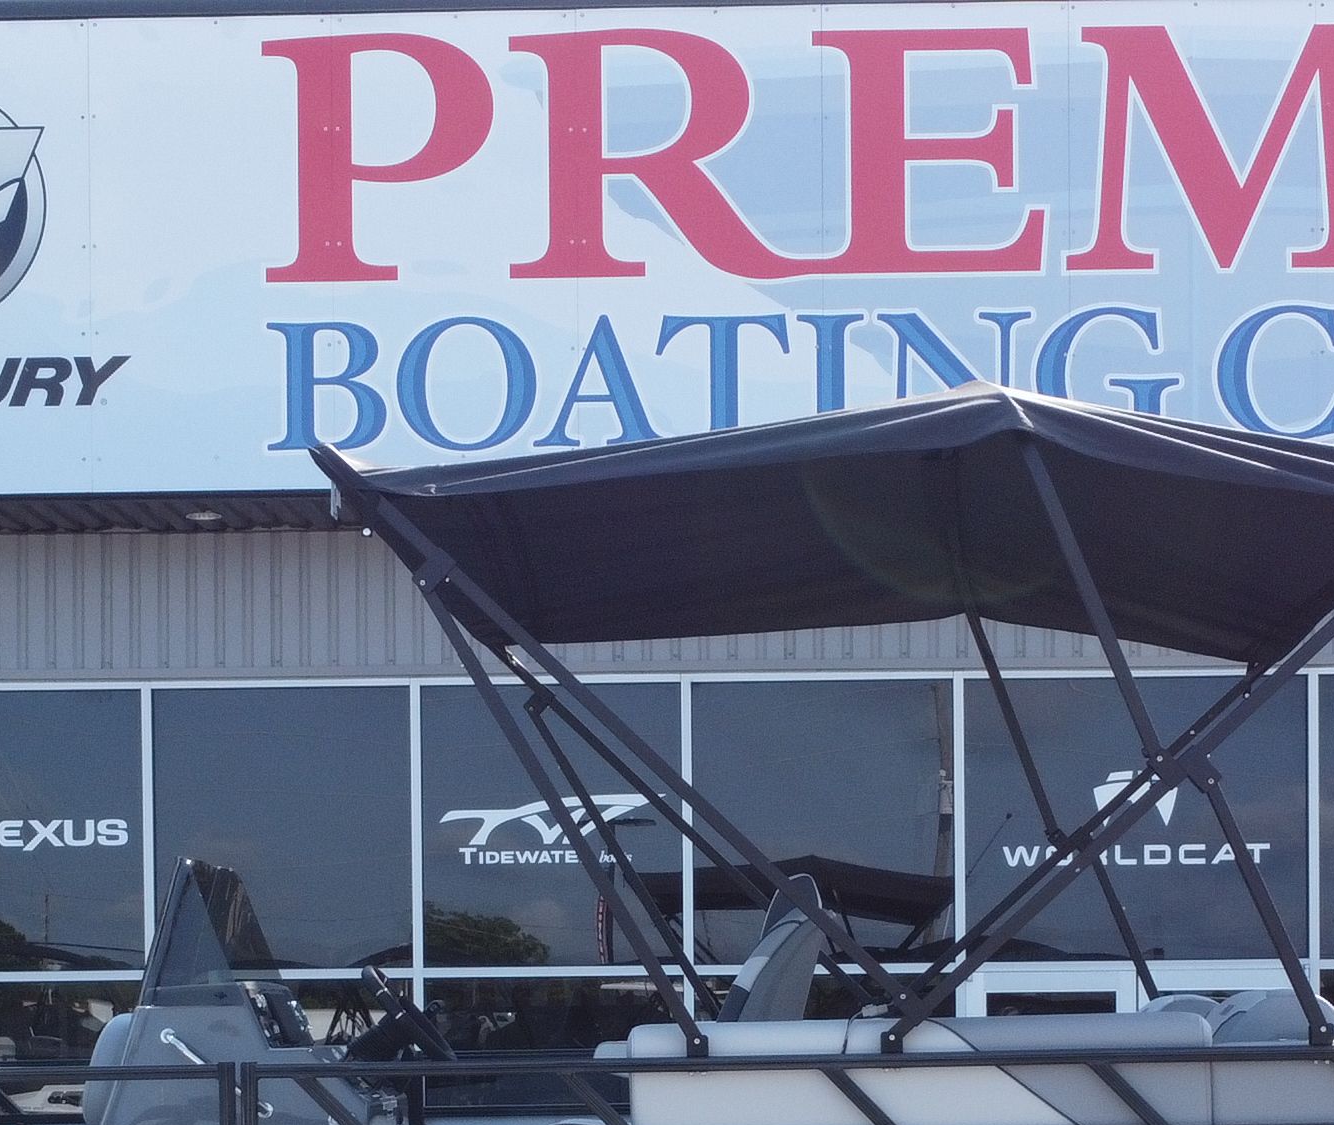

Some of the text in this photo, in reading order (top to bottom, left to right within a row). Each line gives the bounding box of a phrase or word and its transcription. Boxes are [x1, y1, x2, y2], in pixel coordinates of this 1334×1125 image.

[267, 304, 1180, 452] BOATING
[458, 847, 583, 864] TIDEWATE
[1002, 843, 1271, 867] WOLDCAT
